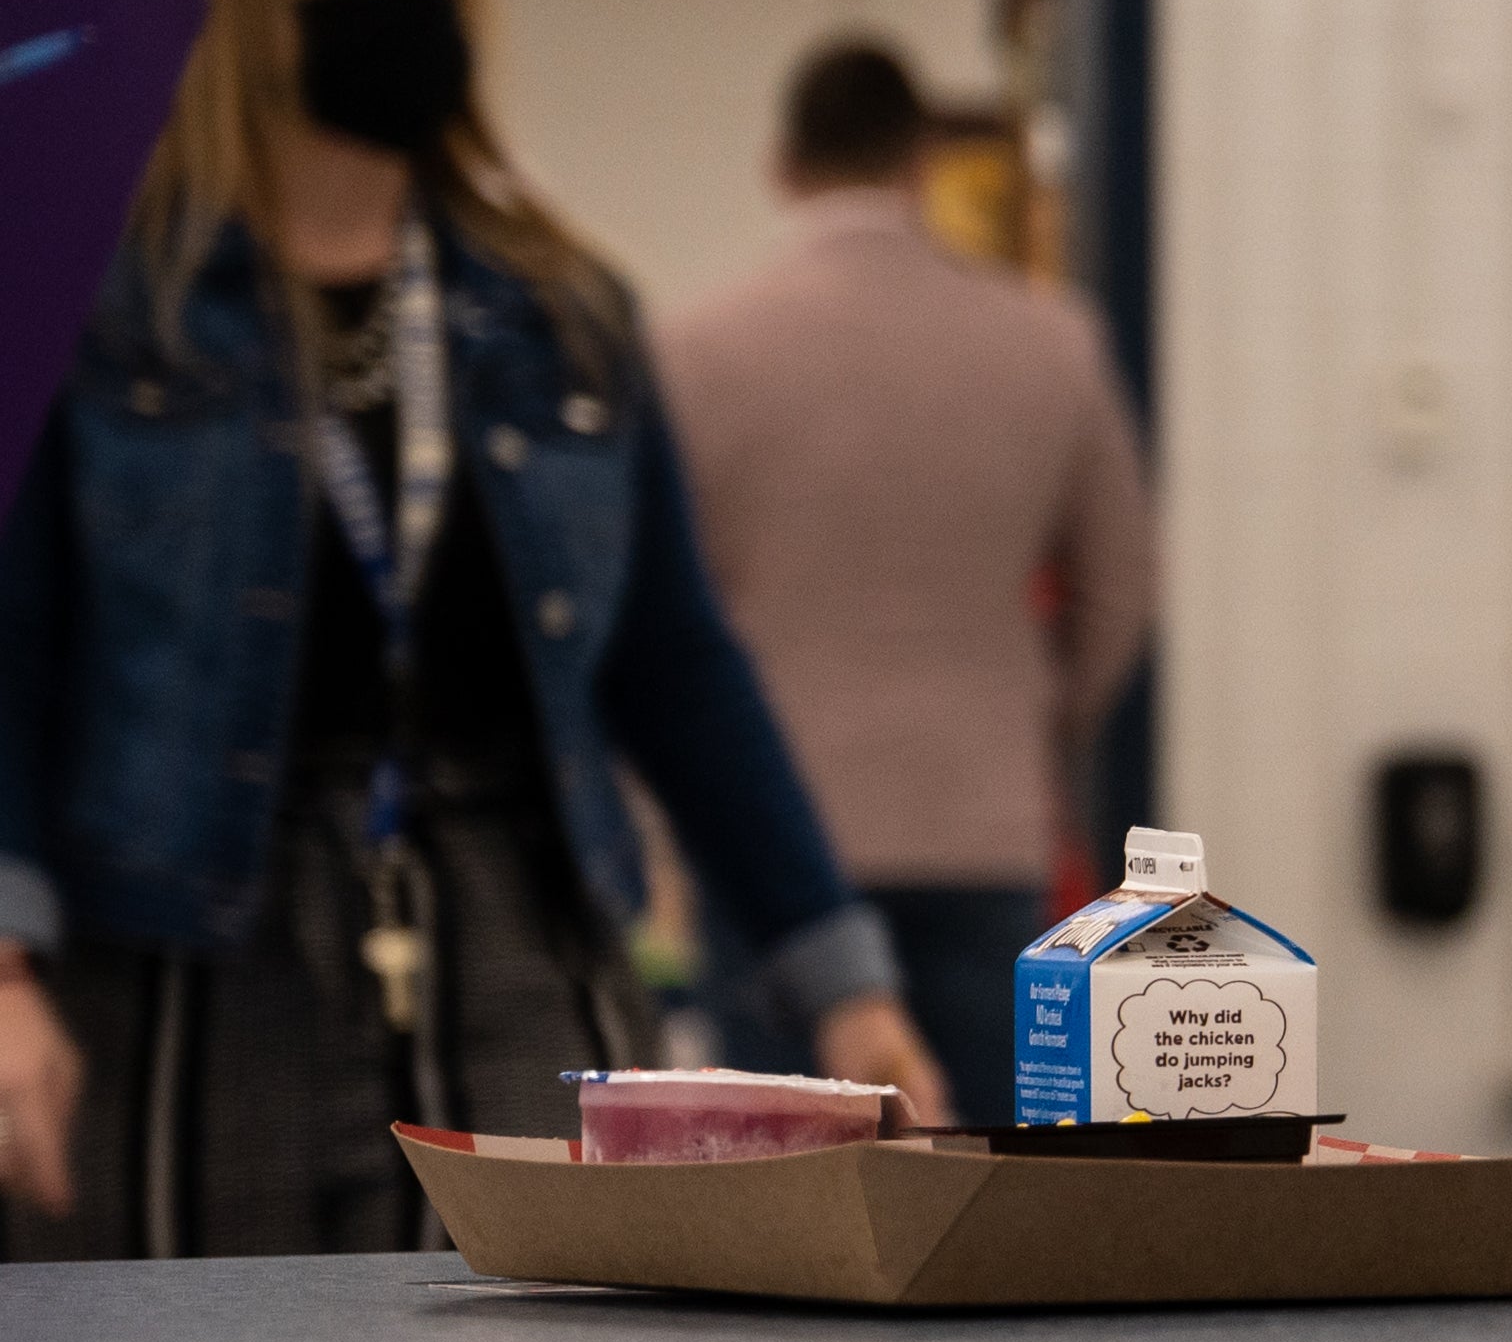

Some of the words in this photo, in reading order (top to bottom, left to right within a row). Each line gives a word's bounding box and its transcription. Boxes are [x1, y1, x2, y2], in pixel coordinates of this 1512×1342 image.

[1169, 1010, 1209, 1027] Why
[1214, 1009, 1242, 1024] did
[1154, 1031, 1183, 1046] the
[1188, 1030, 1255, 1045] chicken
[1155, 1052, 1179, 1067] do
[1183, 1052, 1254, 1070] jumping
[1177, 1074, 1232, 1091] jacks?
